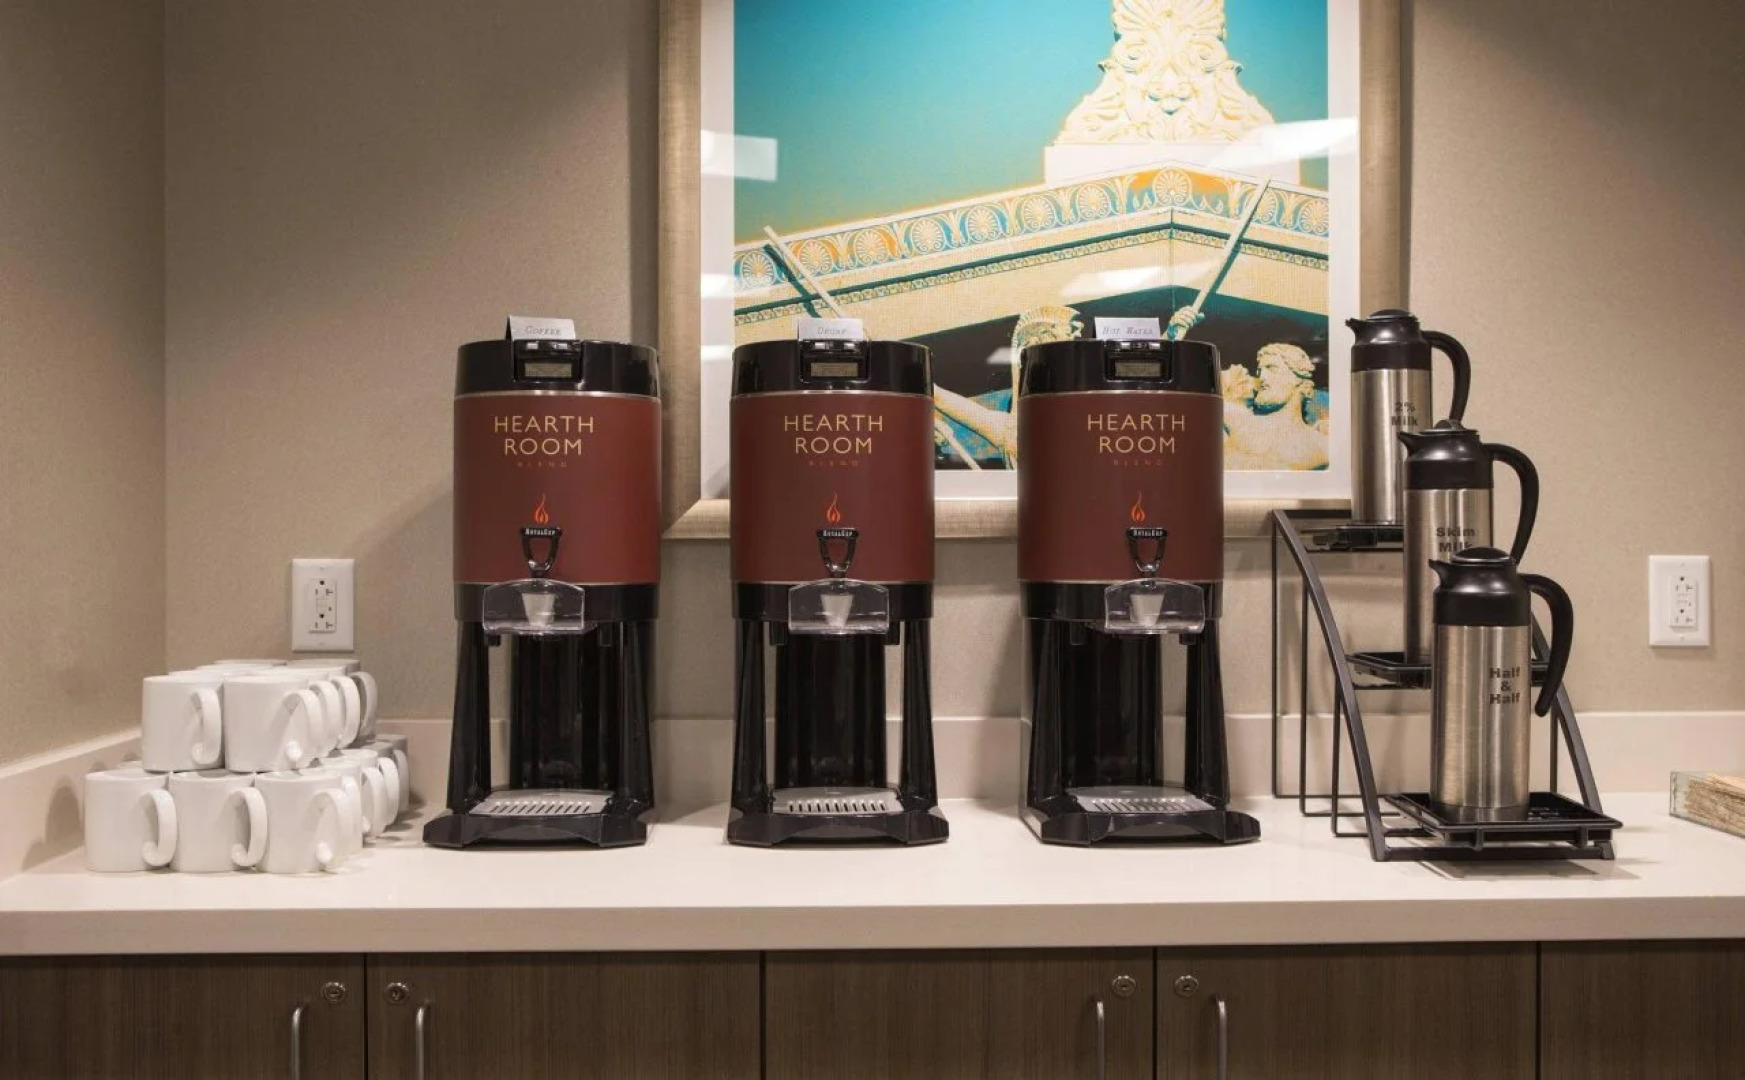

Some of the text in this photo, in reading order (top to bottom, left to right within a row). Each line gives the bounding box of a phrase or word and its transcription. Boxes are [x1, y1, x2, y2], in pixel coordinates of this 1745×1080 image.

[1394, 402, 1416, 413] 2%
[494, 415, 594, 434] HEARTH
[784, 414, 883, 432] HEARTH
[1087, 413, 1186, 431] HEARTH
[1390, 416, 1418, 426] Milk
[504, 438, 582, 456] ROOM
[795, 437, 872, 454] ROOM
[1099, 436, 1175, 454] ROOM
[1436, 527, 1475, 537] Skim
[1489, 667, 1520, 678] Half
[1501, 681, 1511, 691] &
[1489, 693, 1520, 704] Half
